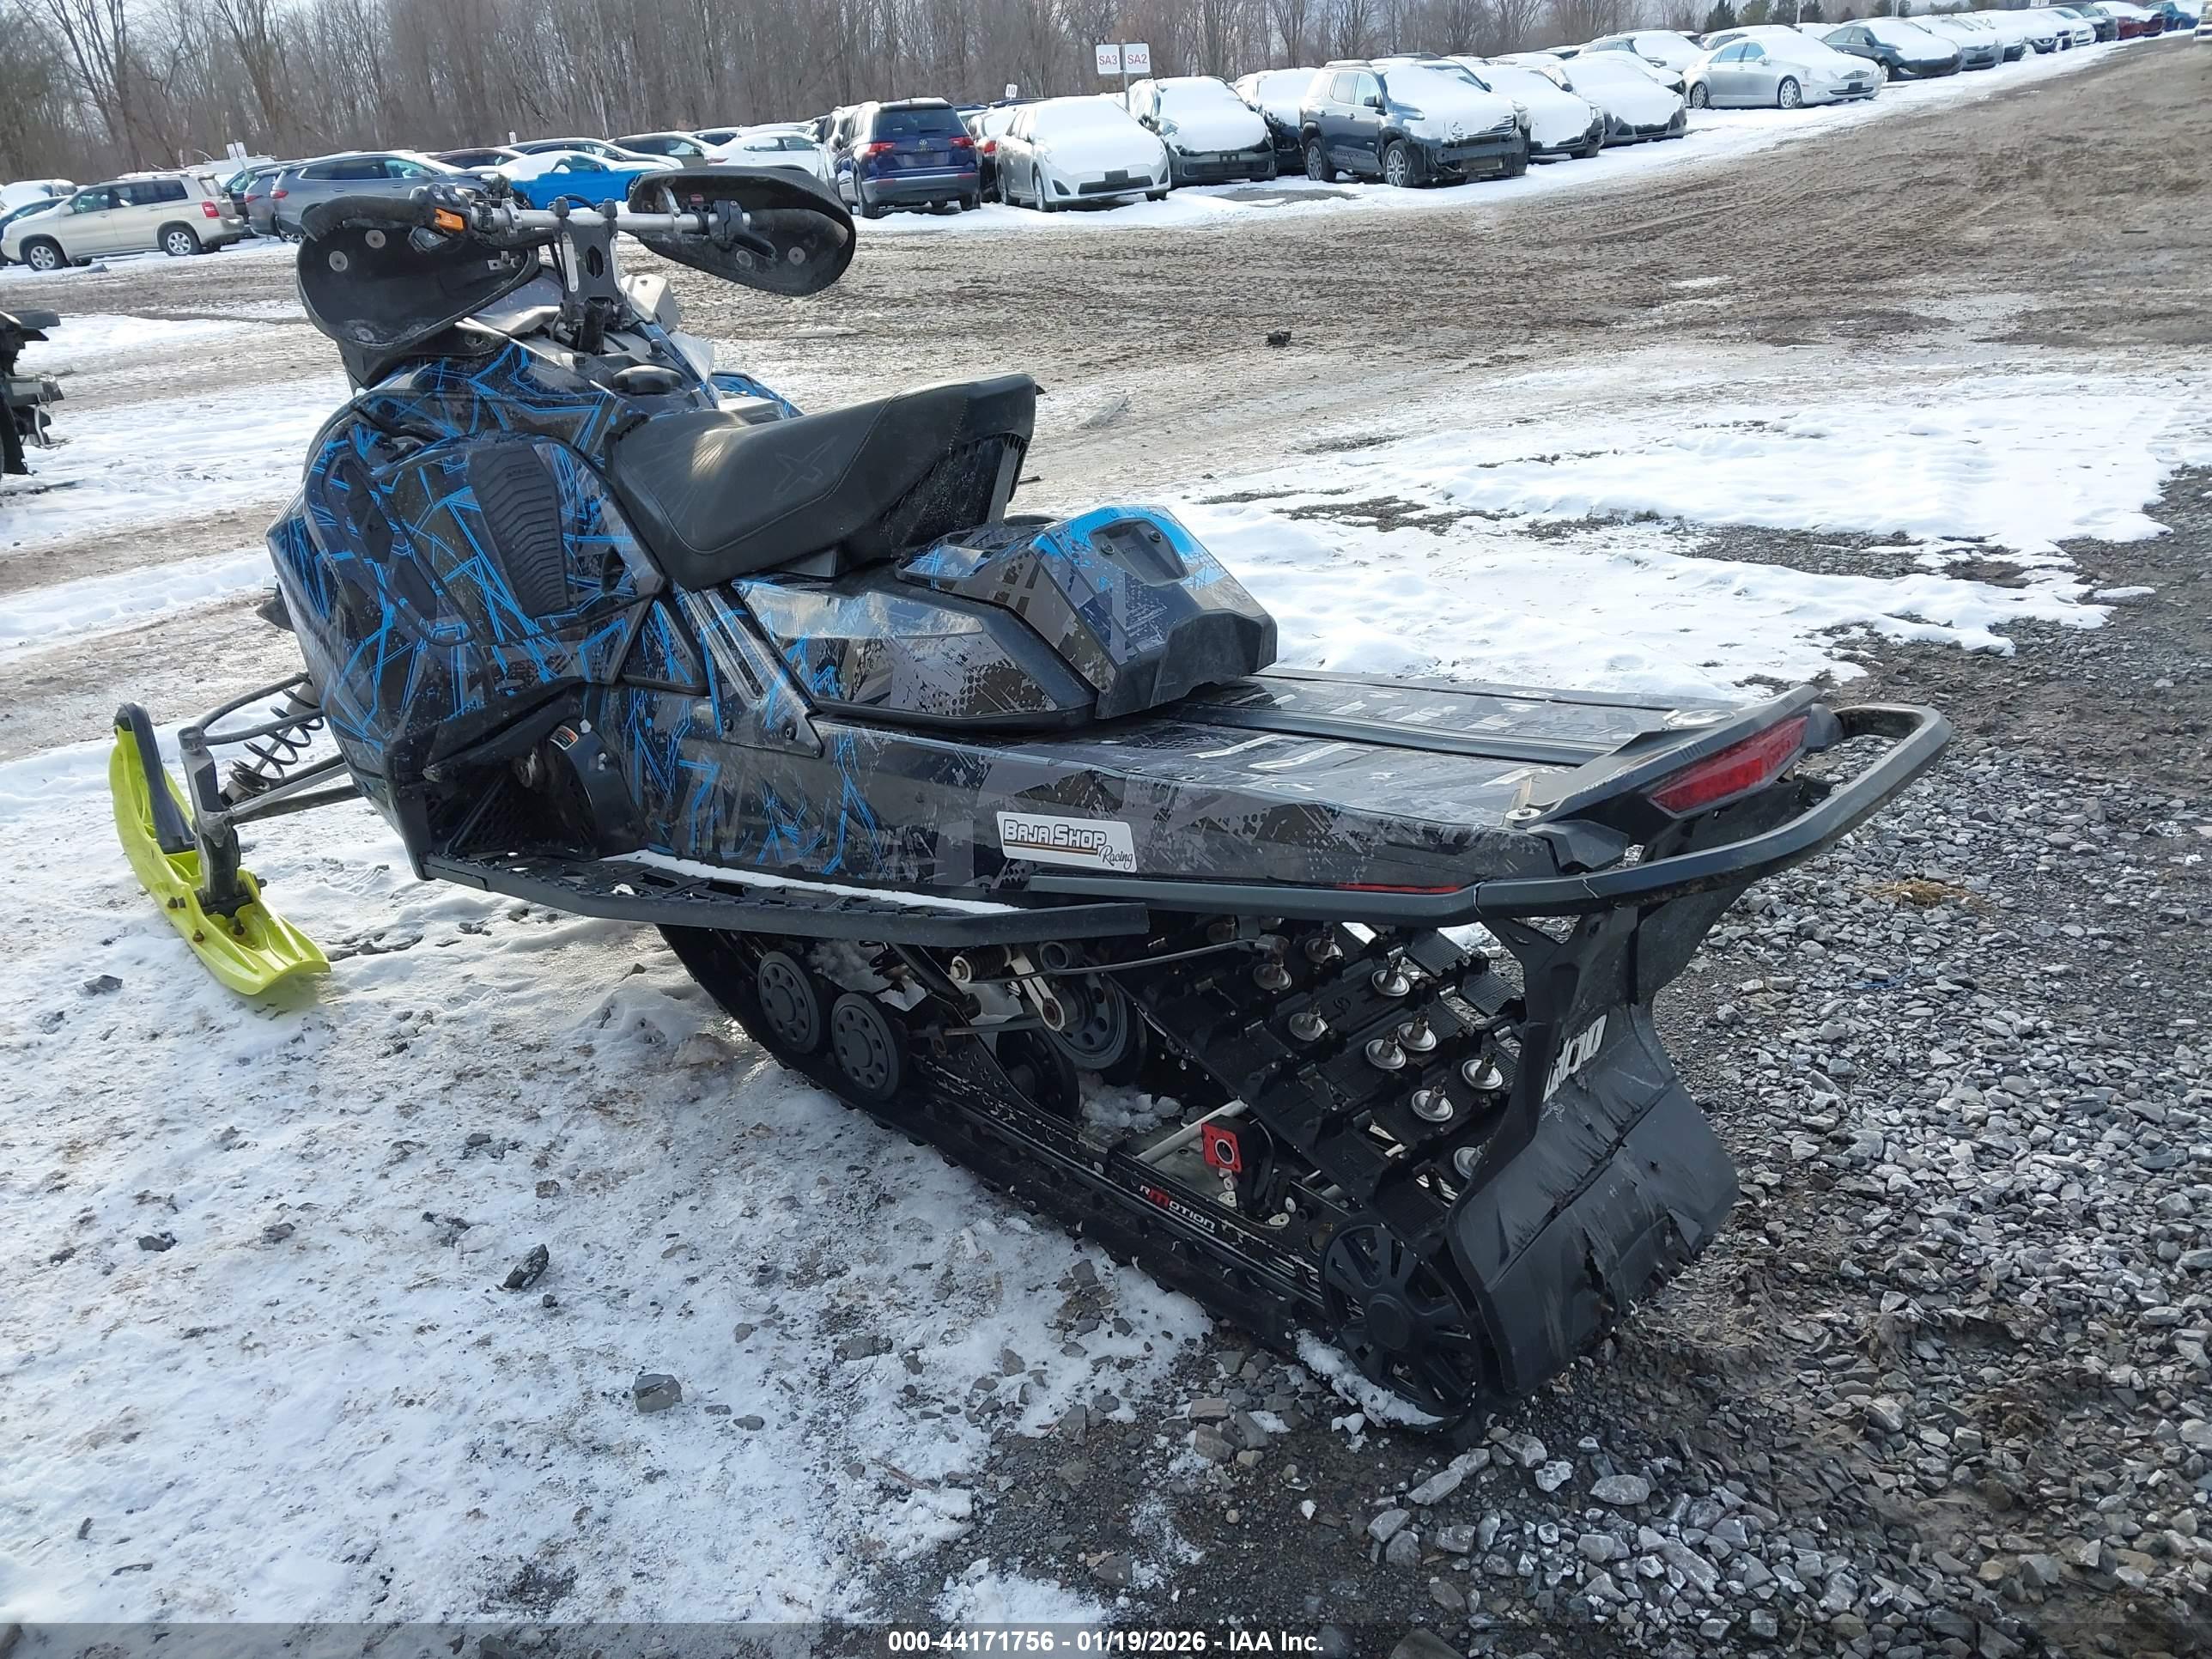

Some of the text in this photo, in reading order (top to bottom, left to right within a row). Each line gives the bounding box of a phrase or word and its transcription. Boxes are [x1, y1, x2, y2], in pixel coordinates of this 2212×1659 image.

[1098, 54, 1118, 65] SA3
[1127, 53, 1148, 64] SA2
[1003, 818, 1107, 850] BAJA SHOP
[1098, 845, 1133, 870] Racing
